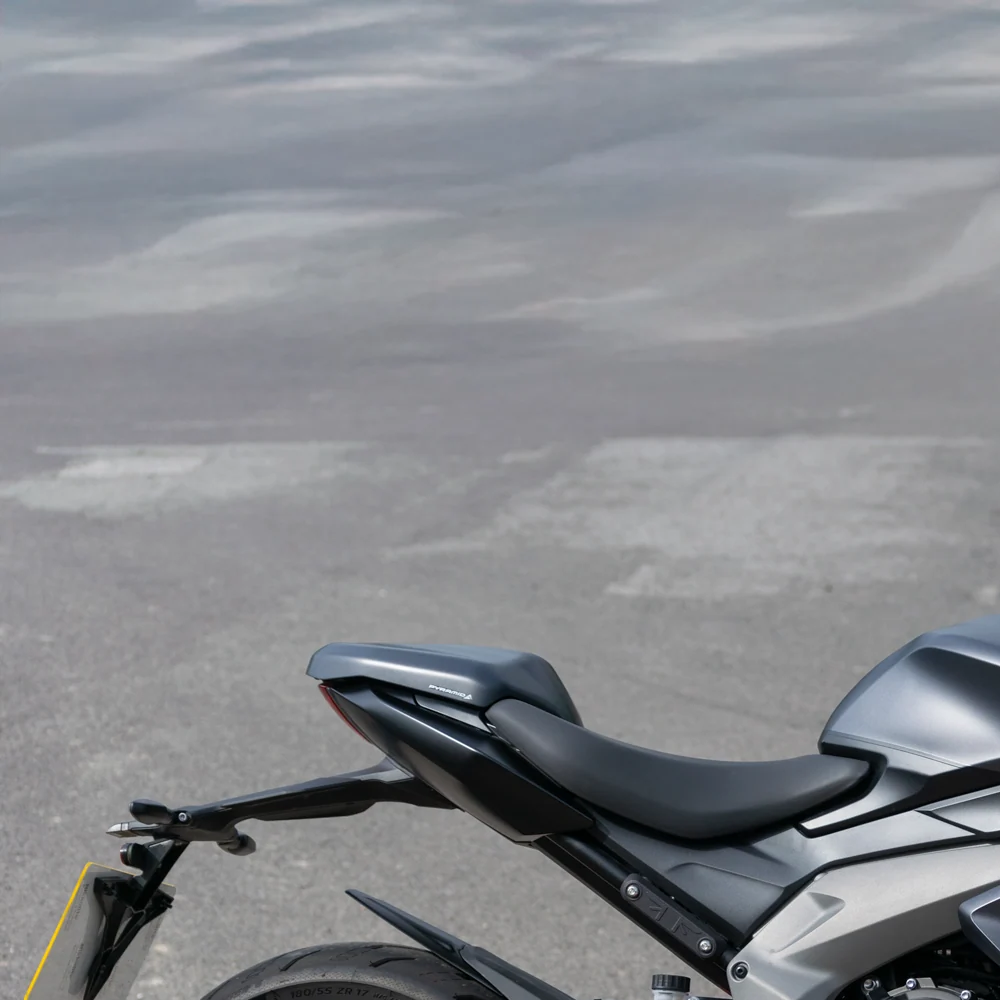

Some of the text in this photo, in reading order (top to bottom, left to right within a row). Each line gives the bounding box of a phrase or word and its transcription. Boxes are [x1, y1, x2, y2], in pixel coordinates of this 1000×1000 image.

[290, 986, 333, 999] 180/55
[335, 986, 353, 996] ZR
[355, 988, 370, 999] 17
